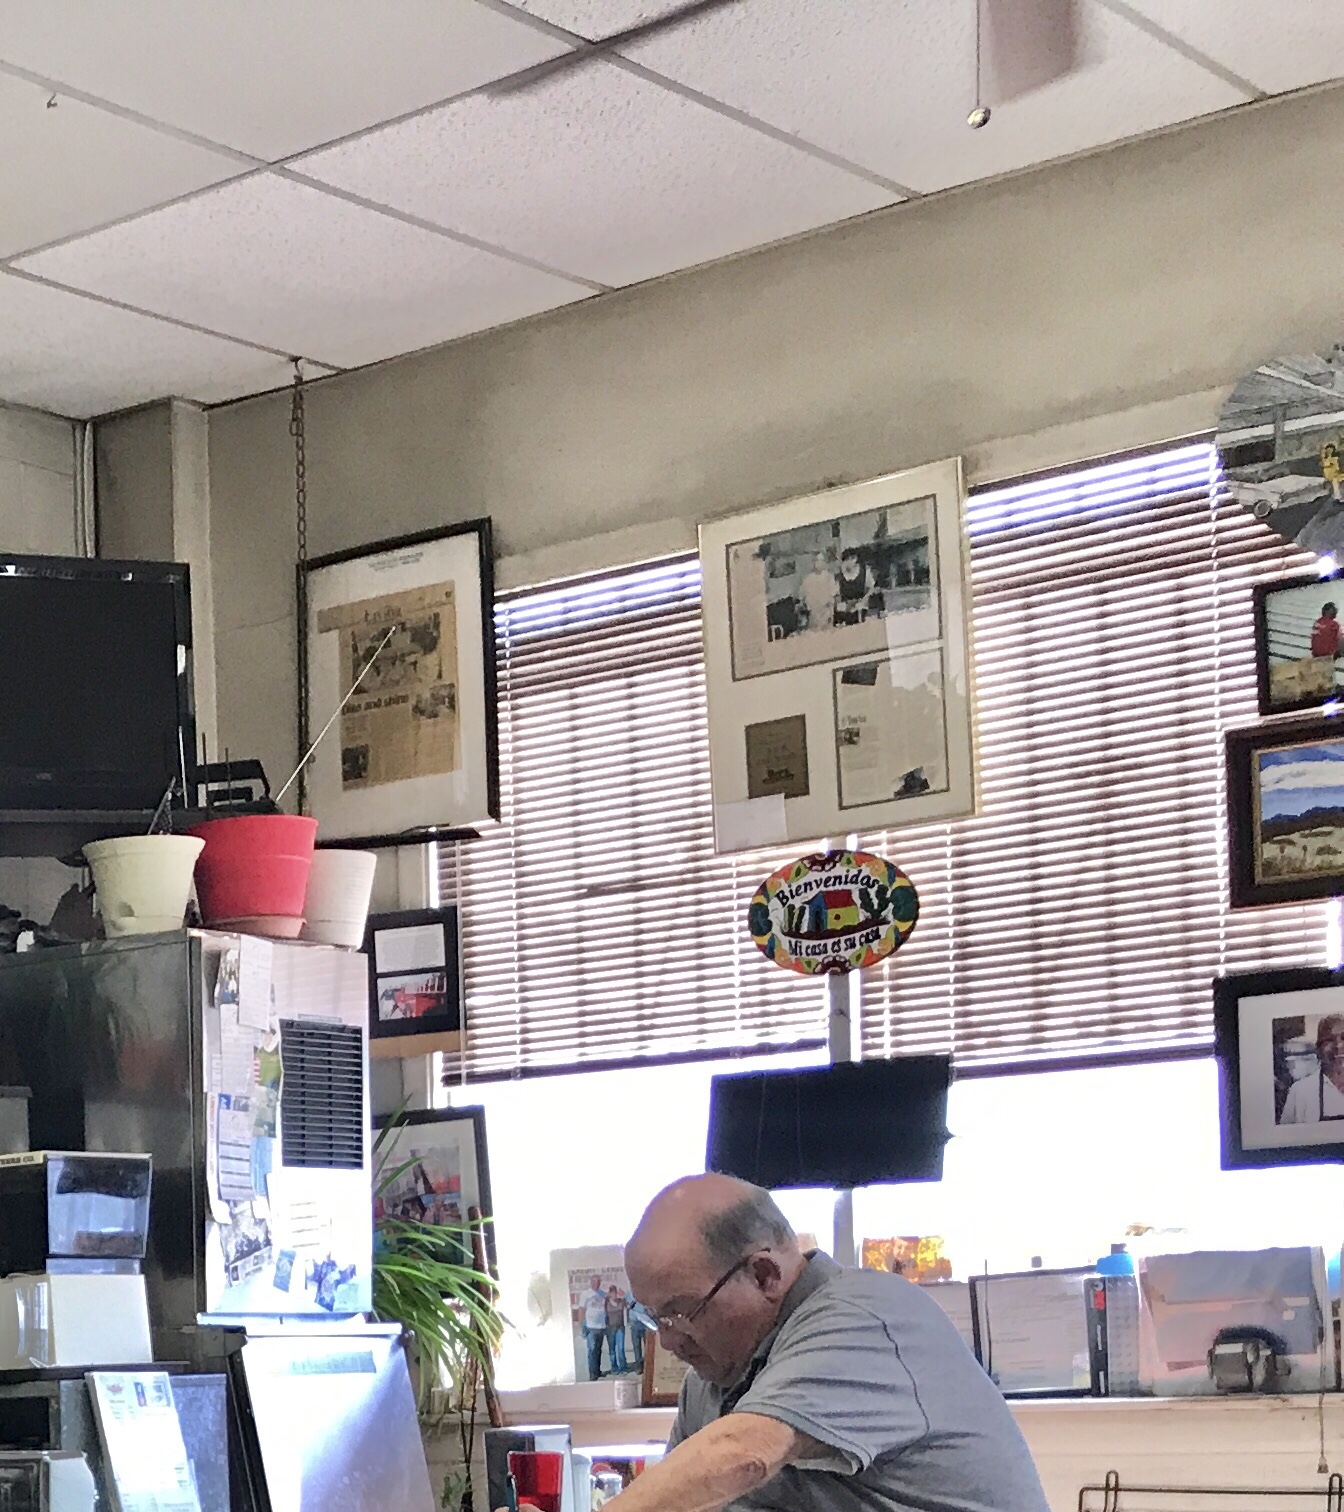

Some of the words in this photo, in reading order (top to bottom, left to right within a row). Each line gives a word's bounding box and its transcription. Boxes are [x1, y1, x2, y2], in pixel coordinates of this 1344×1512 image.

[775, 868, 881, 908] Bienvenidos
[788, 939, 802, 956] Mi
[805, 941, 828, 956] casa
[830, 937, 842, 954] es
[844, 935, 857, 950] su
[859, 926, 881, 947] casa
